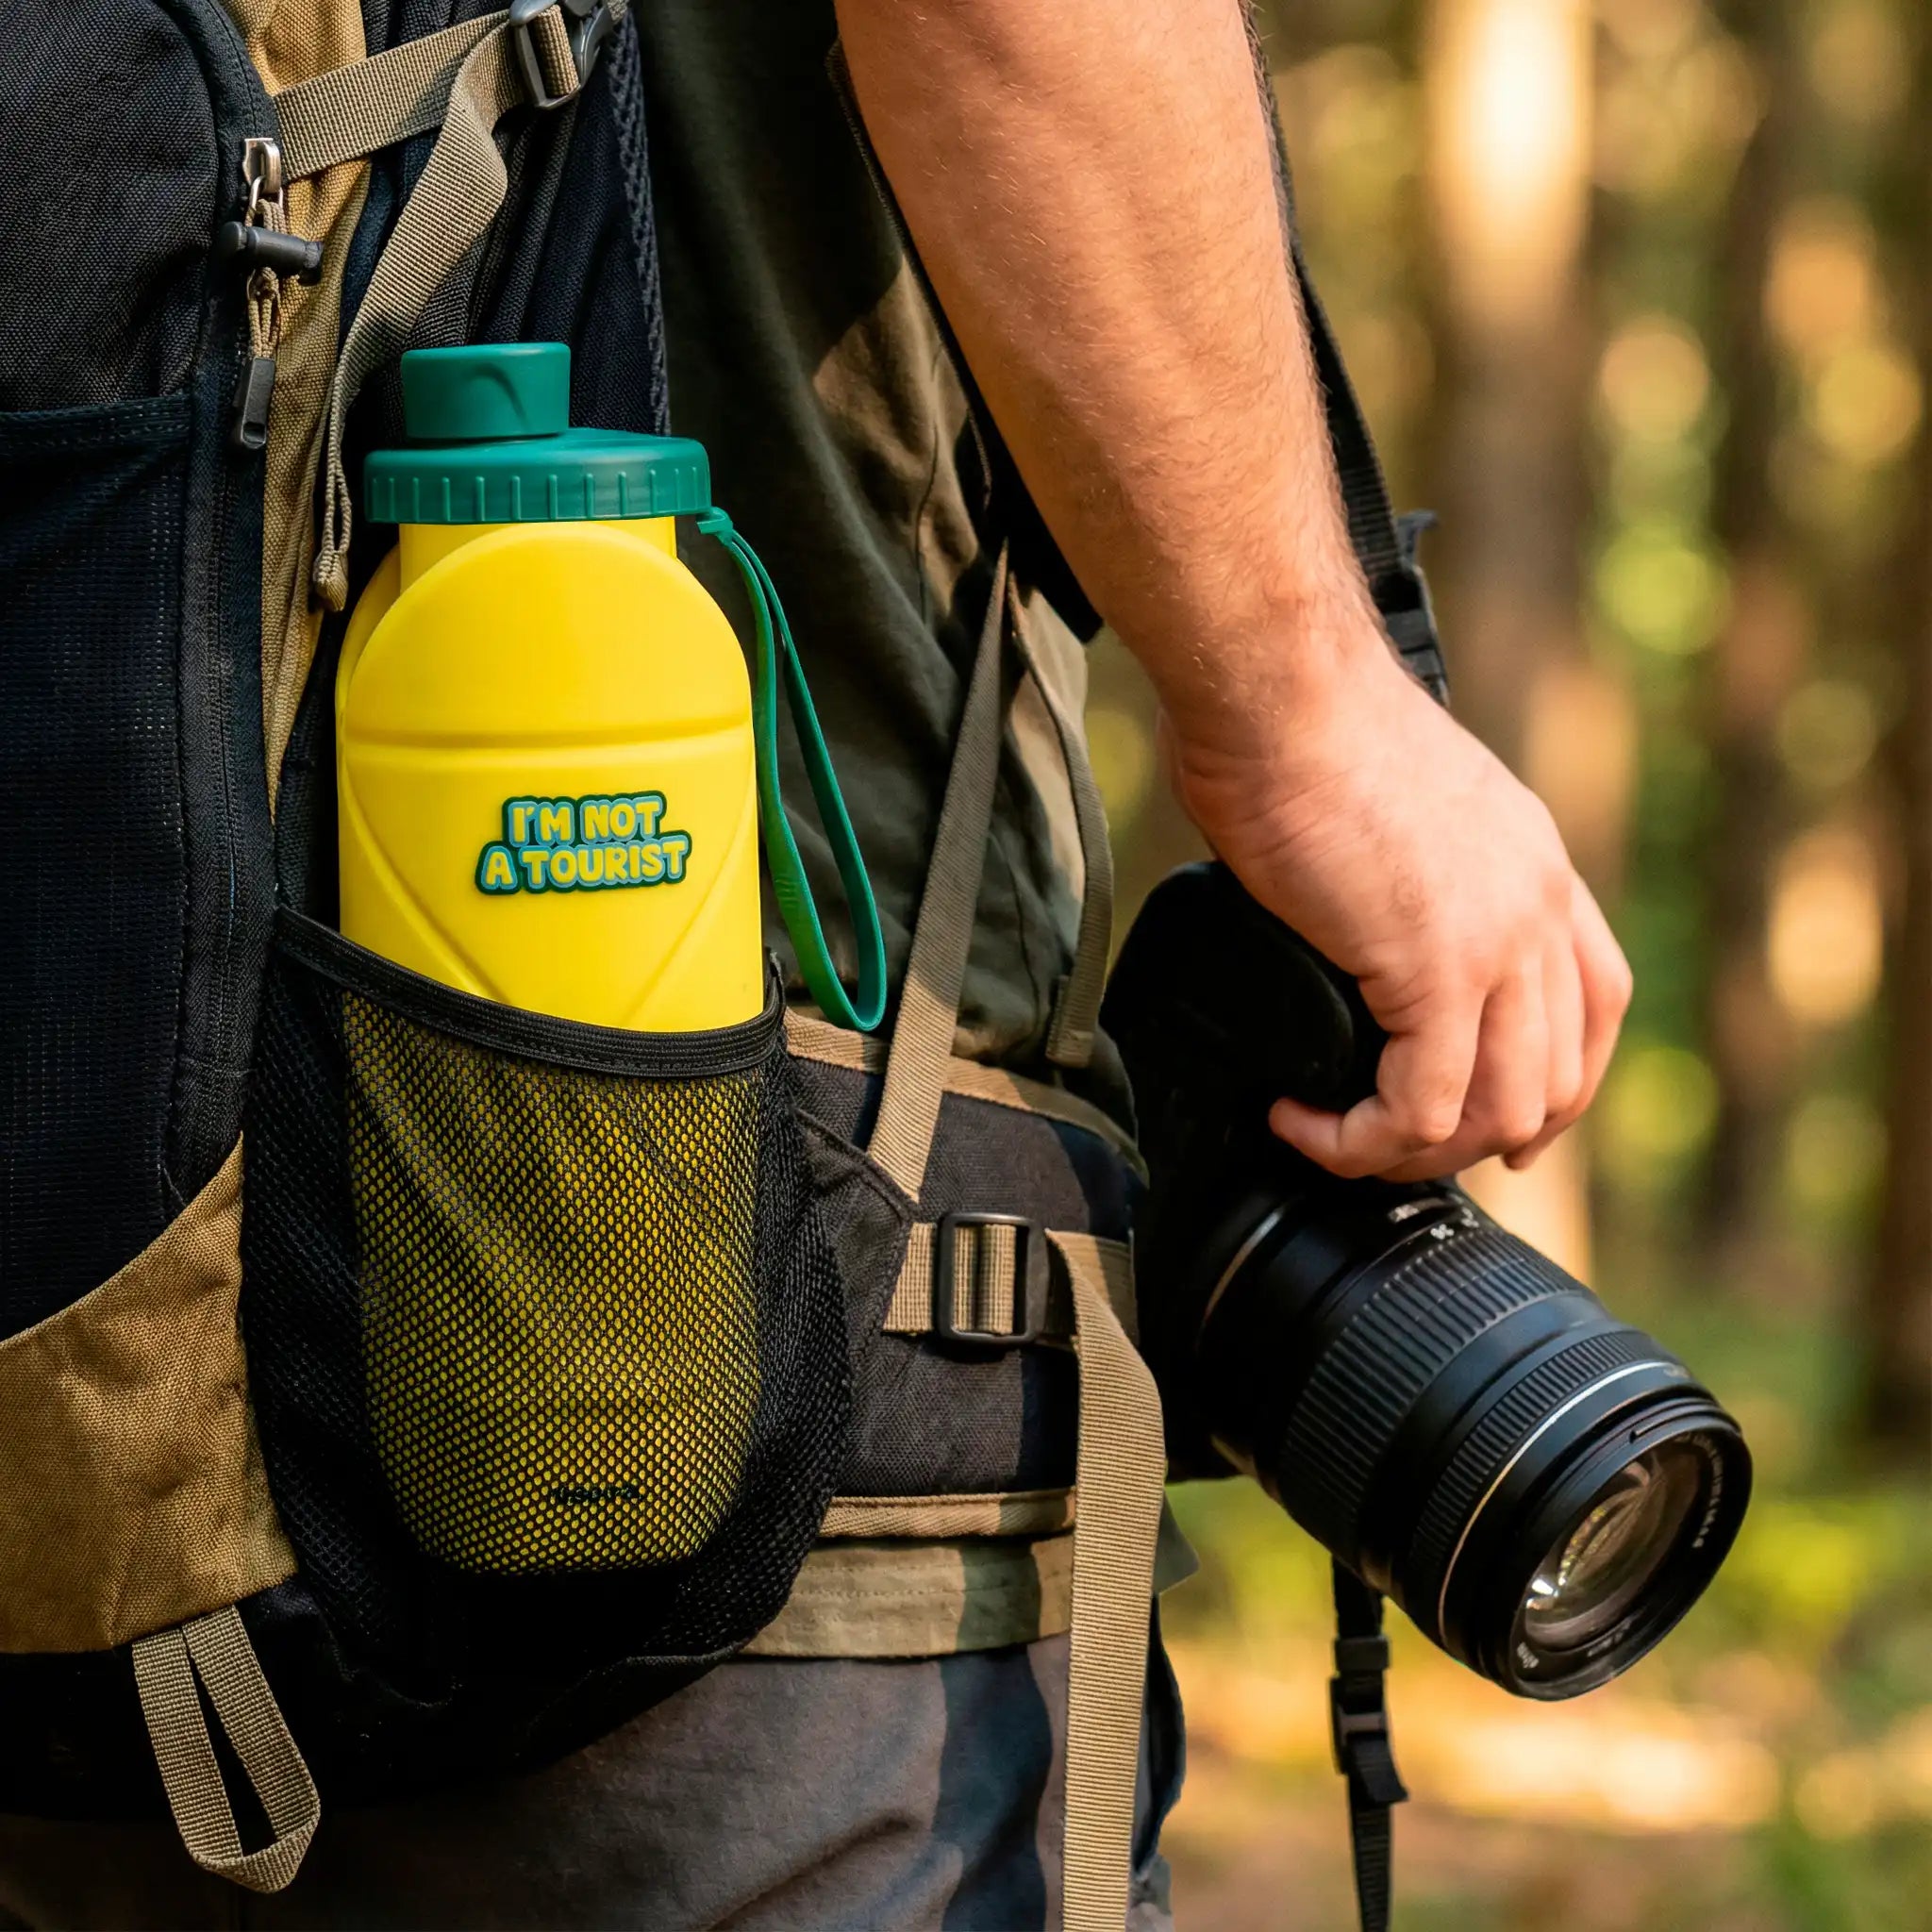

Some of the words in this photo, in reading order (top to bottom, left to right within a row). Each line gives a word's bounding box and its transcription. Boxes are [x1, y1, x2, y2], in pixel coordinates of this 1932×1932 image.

[510, 805, 574, 843] I'M
[582, 800, 662, 842] NOT
[483, 849, 515, 887] A
[520, 839, 687, 886] TOURIST
